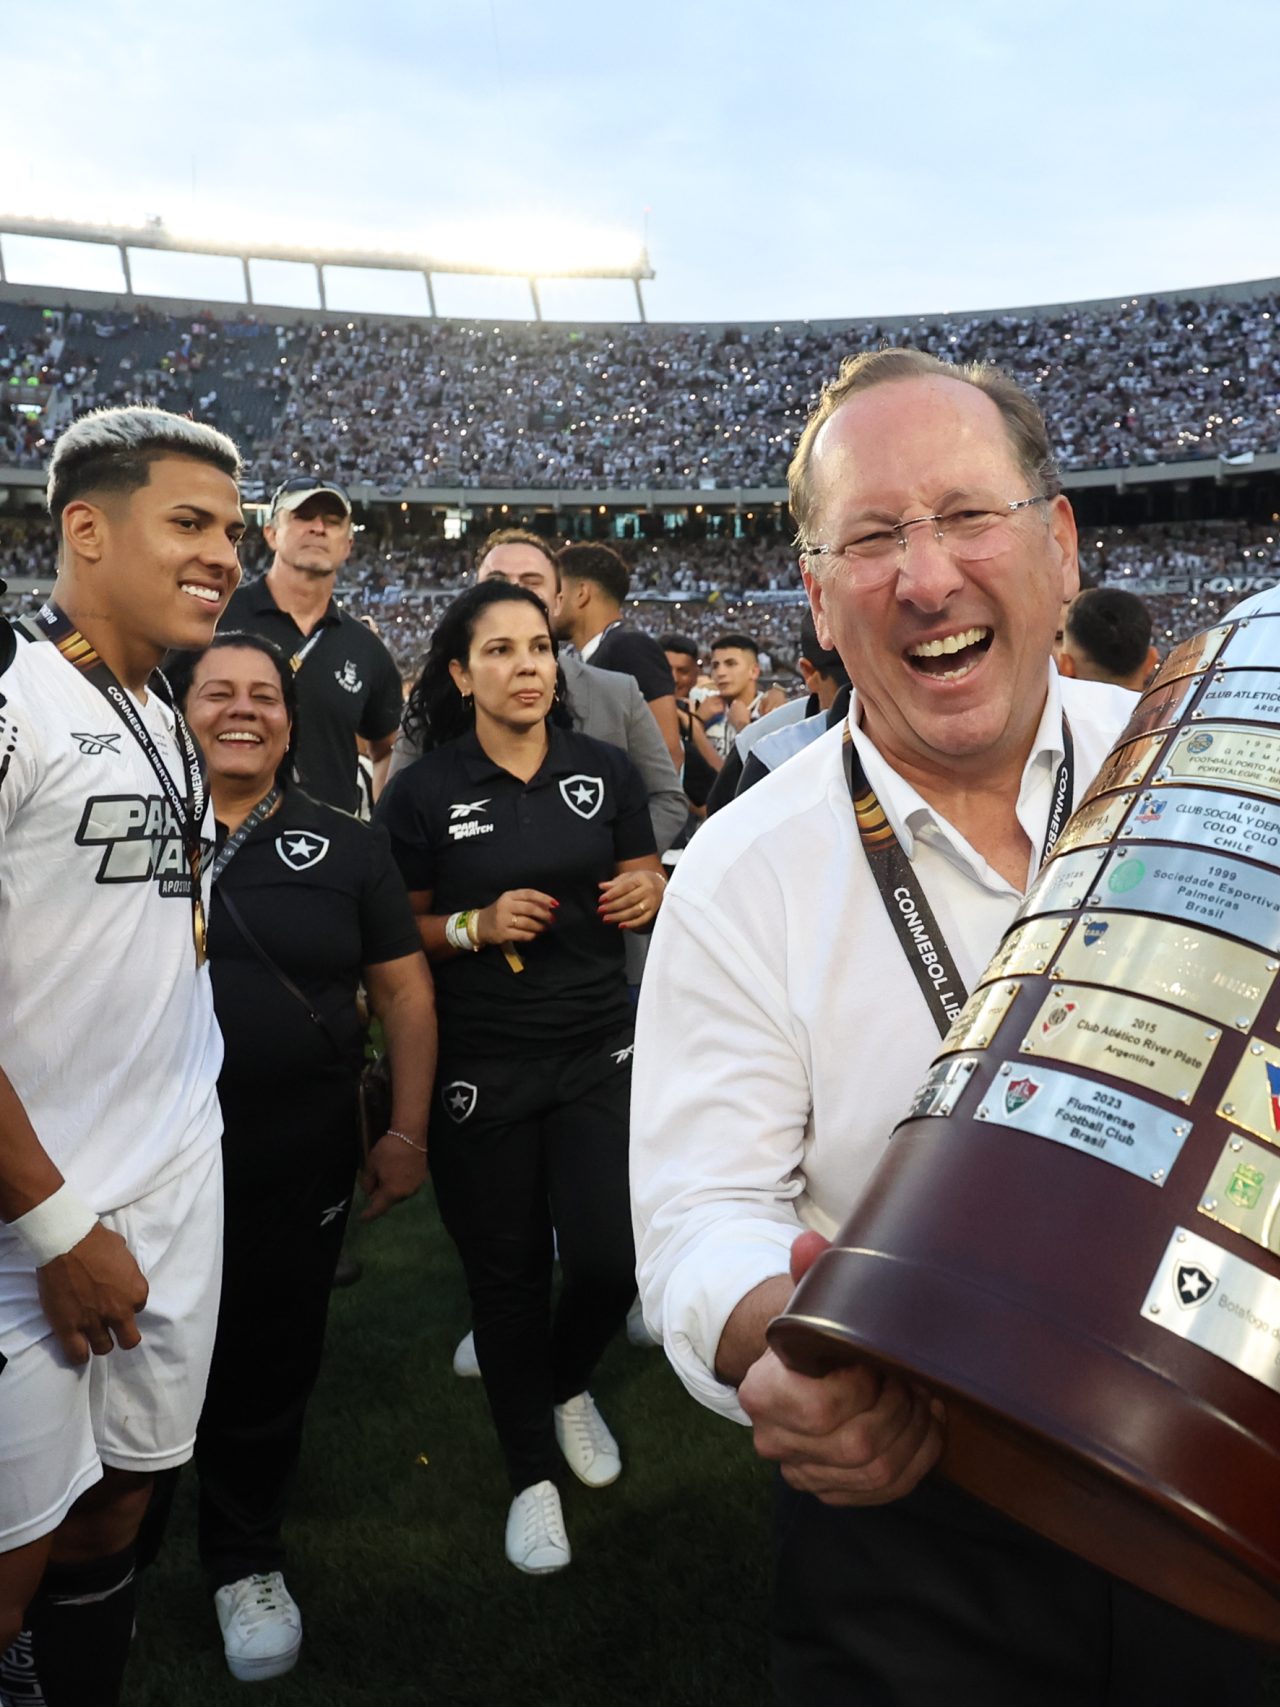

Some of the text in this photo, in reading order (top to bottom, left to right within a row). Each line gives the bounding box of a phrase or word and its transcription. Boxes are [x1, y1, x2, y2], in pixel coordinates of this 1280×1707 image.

[1205, 691, 1232, 699] CLUB
[106, 685, 151, 746] CONMEBOL
[147, 744, 187, 825] LIBERTADORES
[1235, 759, 1266, 771] PORTO
[1228, 768, 1262, 781] ALEGRE
[1175, 804, 1202, 815] CLUB
[1204, 807, 1243, 824] SOCIAL
[1246, 816, 1255, 826] Y
[1203, 820, 1279, 847] COLO COLO
[1213, 837, 1254, 853] CHILE
[1208, 865, 1238, 881] 1999
[1153, 869, 1280, 912] Sociedade Esportiva
[1176, 885, 1240, 911] Palmeiras
[1184, 900, 1225, 920] Brasil
[893, 886, 949, 991] CONMEBOL
[1131, 1017, 1158, 1034] 2015
[1076, 1018, 1100, 1033] Club
[1142, 1038, 1172, 1057] River
[1173, 1049, 1203, 1070] Plate
[1105, 1044, 1156, 1068] Argentina
[1092, 1090, 1123, 1110] 2023
[1066, 1096, 1136, 1131] Fluminense
[1054, 1107, 1136, 1147] Football Club
[1069, 1126, 1107, 1149] Brasil
[1217, 1292, 1271, 1333] Botafogo
